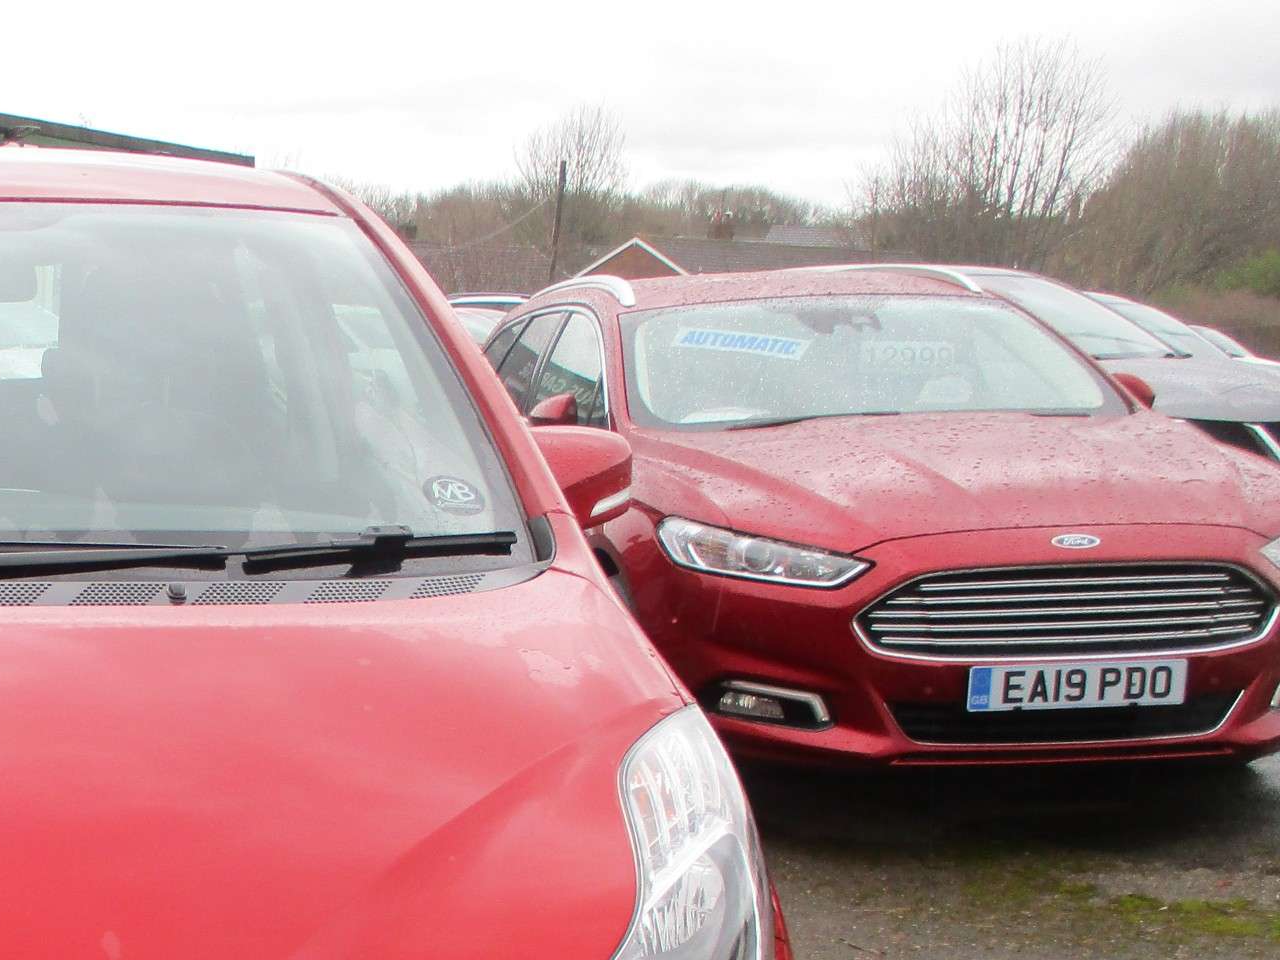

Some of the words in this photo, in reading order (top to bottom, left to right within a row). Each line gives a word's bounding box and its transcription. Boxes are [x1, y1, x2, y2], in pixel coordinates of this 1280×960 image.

[680, 330, 802, 355] AUTOMATIC
[1002, 669, 1087, 704] EA19
[1097, 666, 1173, 700] PDO
